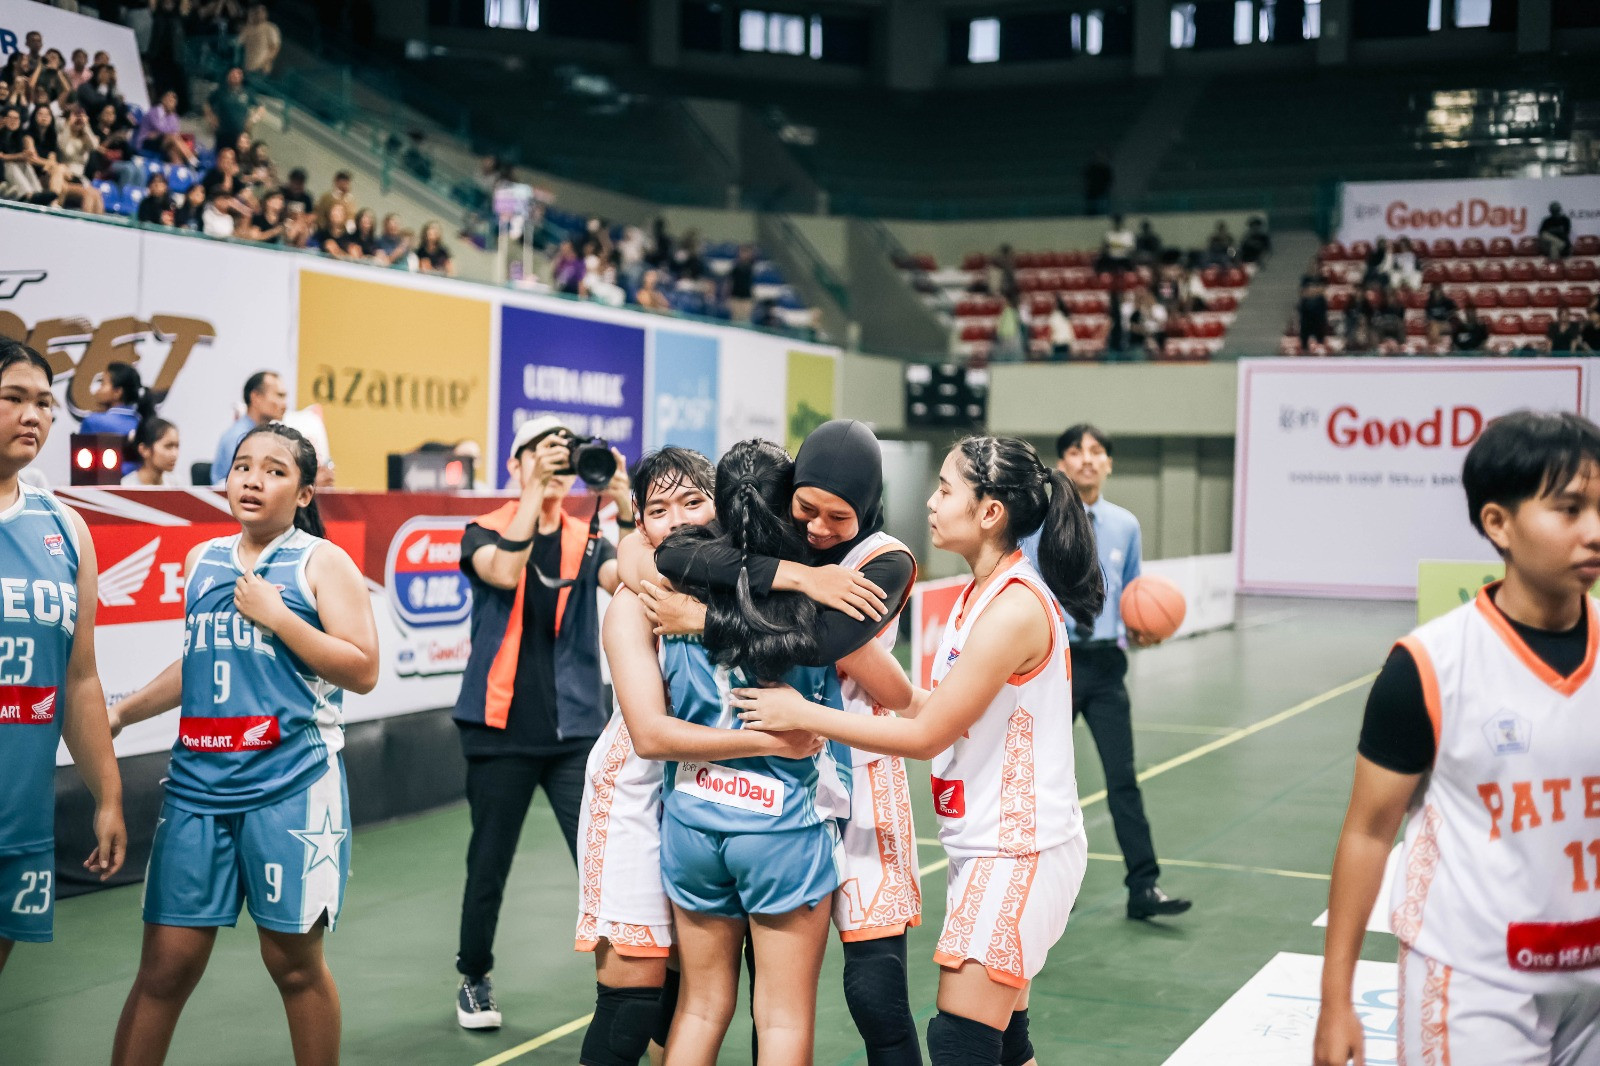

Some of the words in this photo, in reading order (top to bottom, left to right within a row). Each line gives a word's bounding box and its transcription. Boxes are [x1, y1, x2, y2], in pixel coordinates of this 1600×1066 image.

[312, 364, 472, 418] azarine
[0, 636, 35, 685] 23
[213, 660, 231, 704] 9
[182, 734, 200, 748] One
[11, 870, 52, 914] 23
[264, 862, 283, 903] 9
[1516, 949, 1555, 967] One
